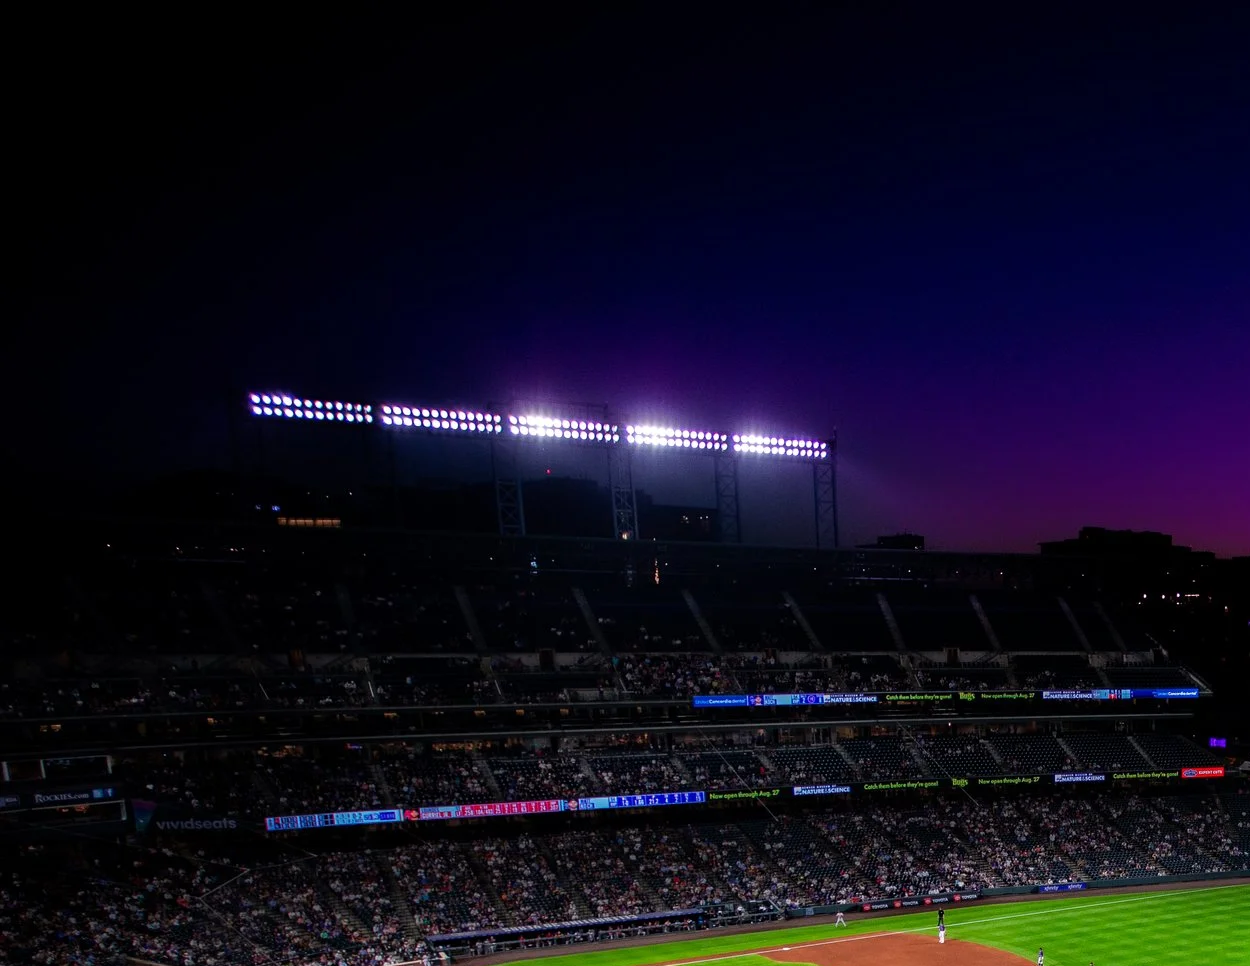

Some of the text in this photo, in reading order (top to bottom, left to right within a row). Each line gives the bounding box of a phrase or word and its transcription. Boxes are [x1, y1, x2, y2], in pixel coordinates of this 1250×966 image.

[959, 692, 975, 701] Bugs
[952, 777, 968, 787] Bugs
[34, 792, 90, 804] ROCKIES.com
[156, 818, 238, 830] vividseats
